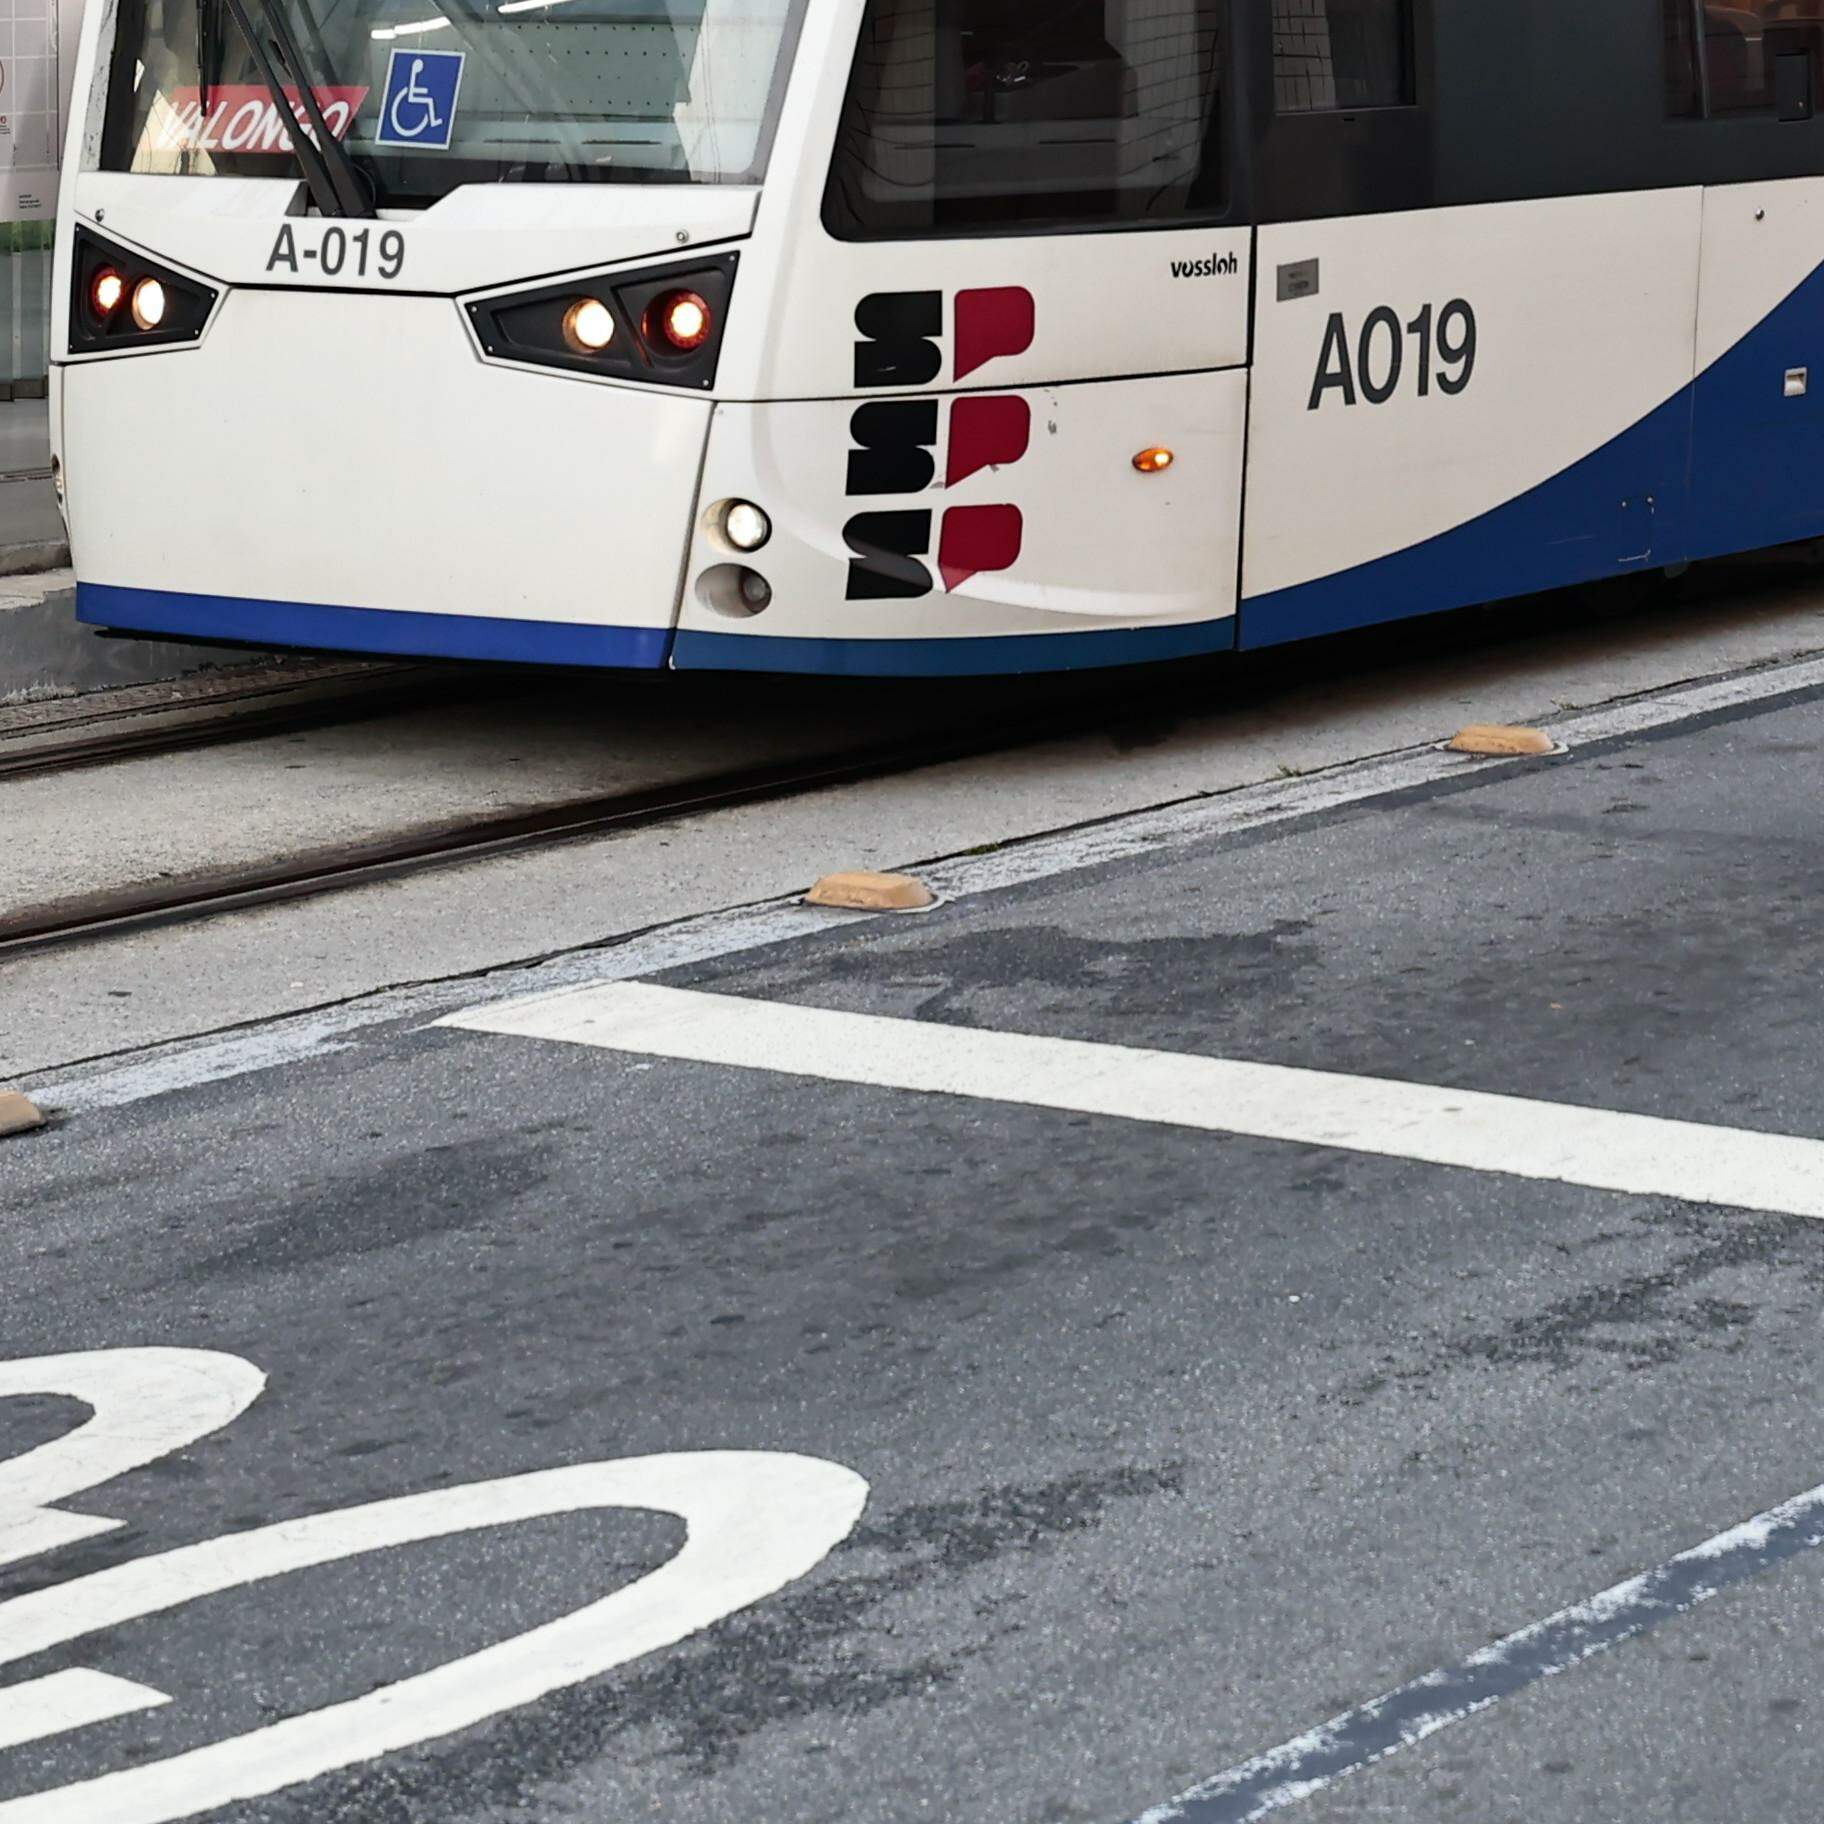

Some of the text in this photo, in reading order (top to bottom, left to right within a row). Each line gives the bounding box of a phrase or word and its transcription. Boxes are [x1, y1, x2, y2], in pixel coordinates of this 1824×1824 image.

[265, 223, 405, 280] A-019
[1171, 251, 1238, 278] vossloh
[1307, 298, 1477, 410] A019
